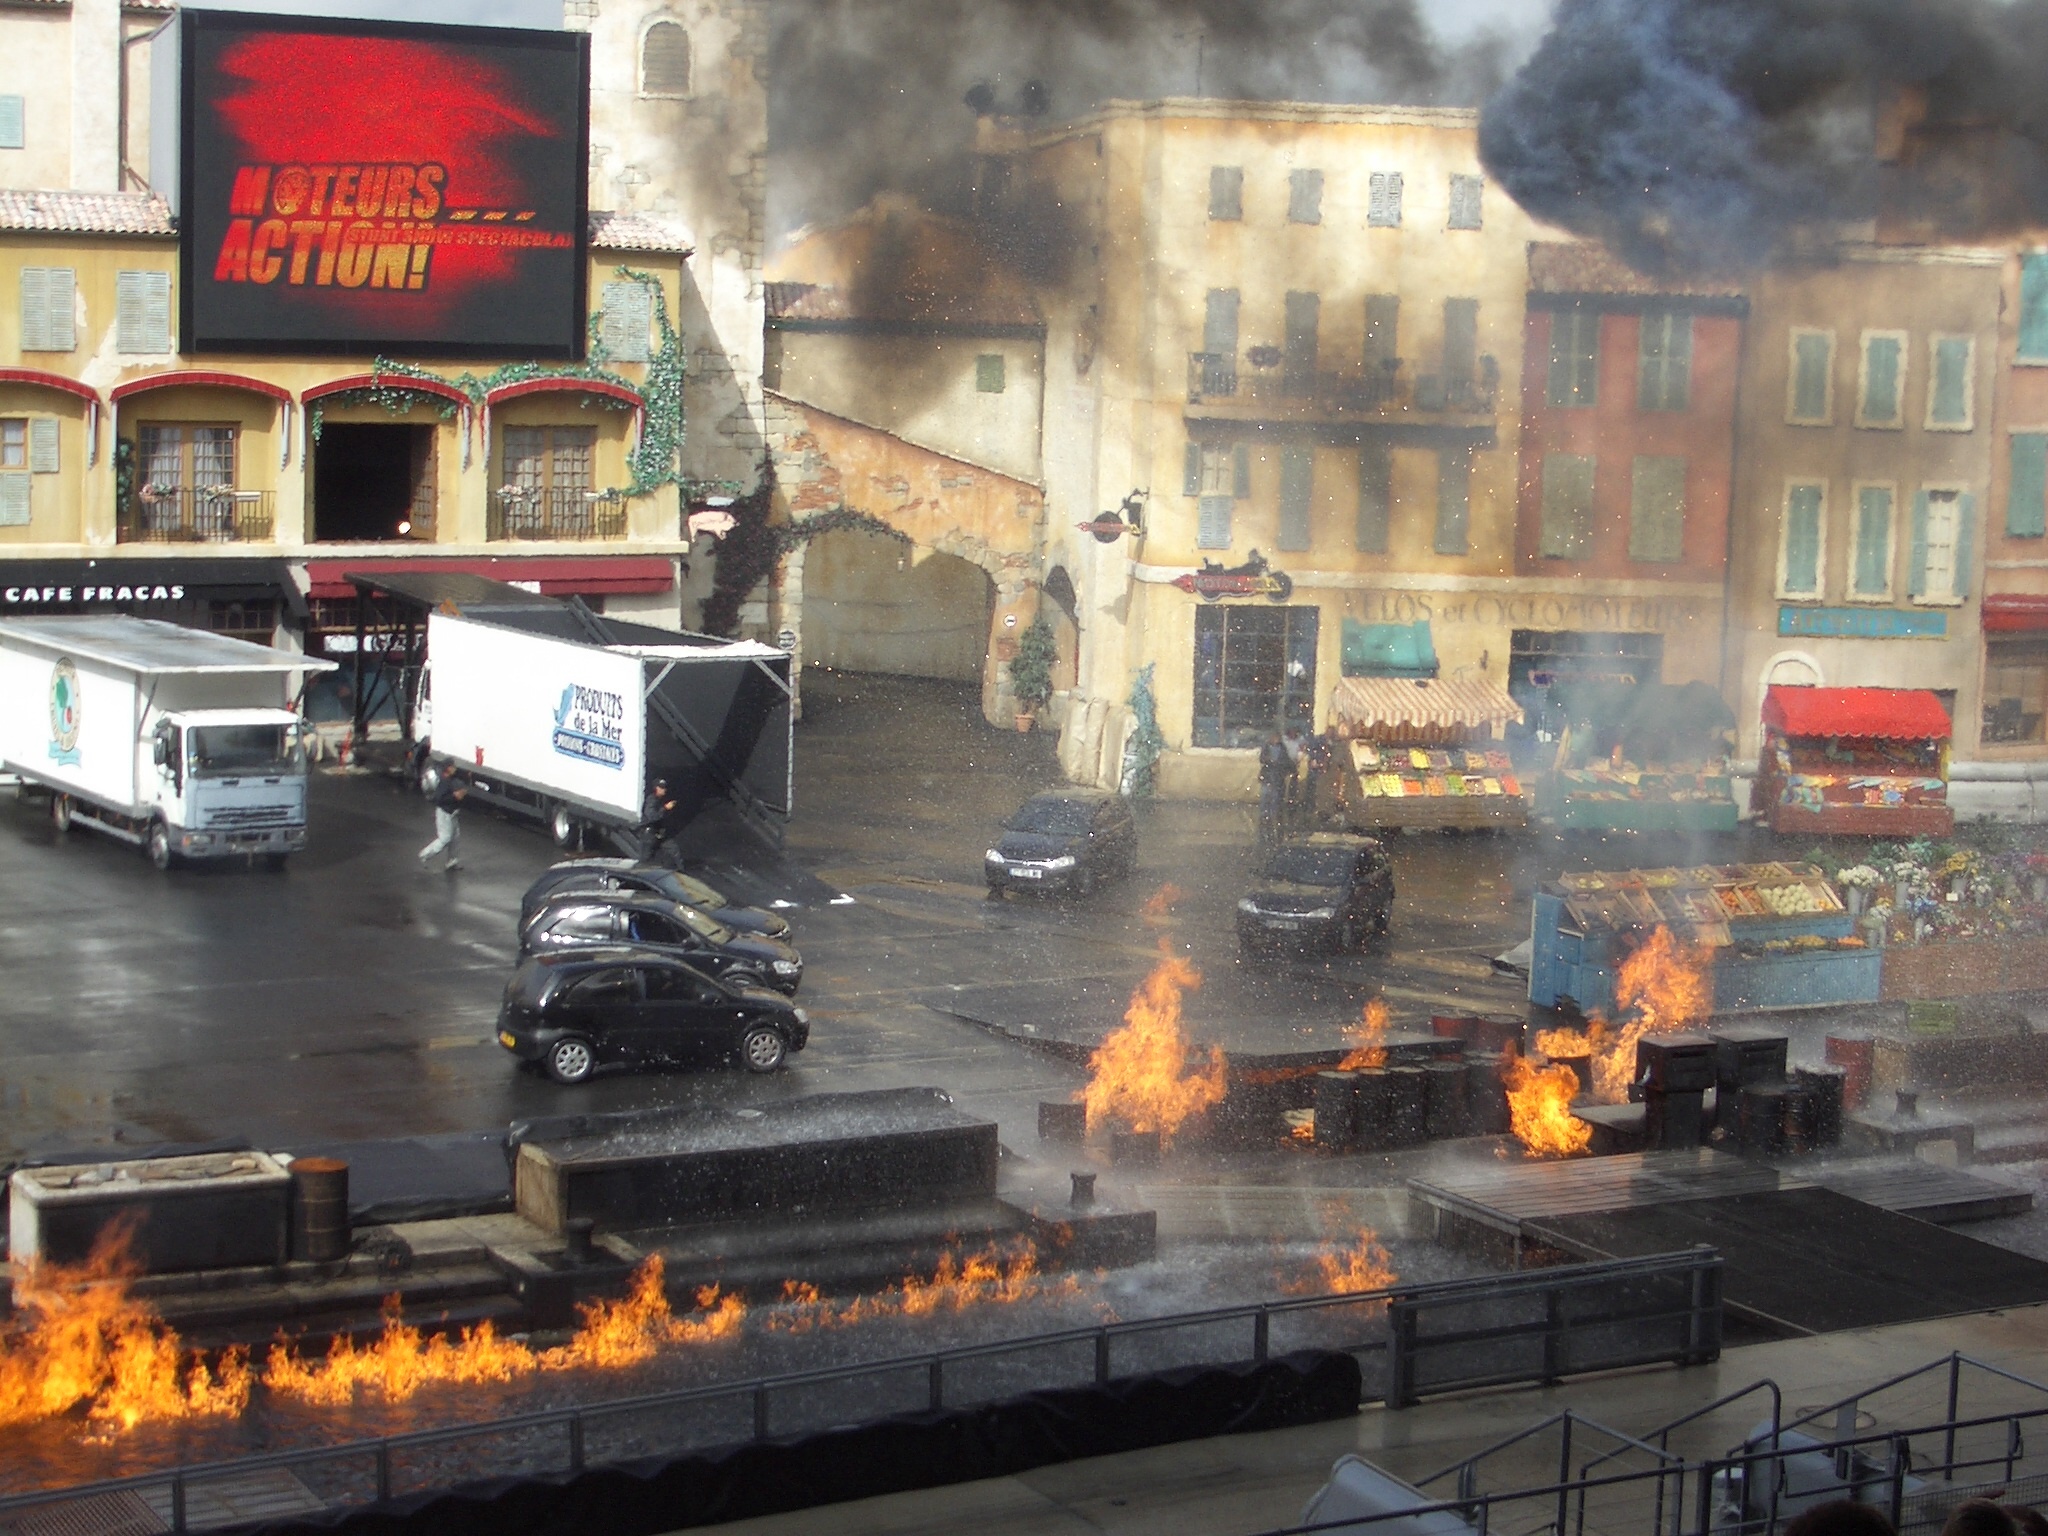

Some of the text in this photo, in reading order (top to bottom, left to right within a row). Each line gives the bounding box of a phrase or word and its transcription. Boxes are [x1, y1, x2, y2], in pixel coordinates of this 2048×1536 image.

[402, 229, 454, 245] SHOW
[213, 219, 433, 289] ACTION!
[5, 585, 185, 602] CAFE FRACAS
[575, 684, 623, 720] PRODUITS
[574, 712, 622, 741] de la Mer
